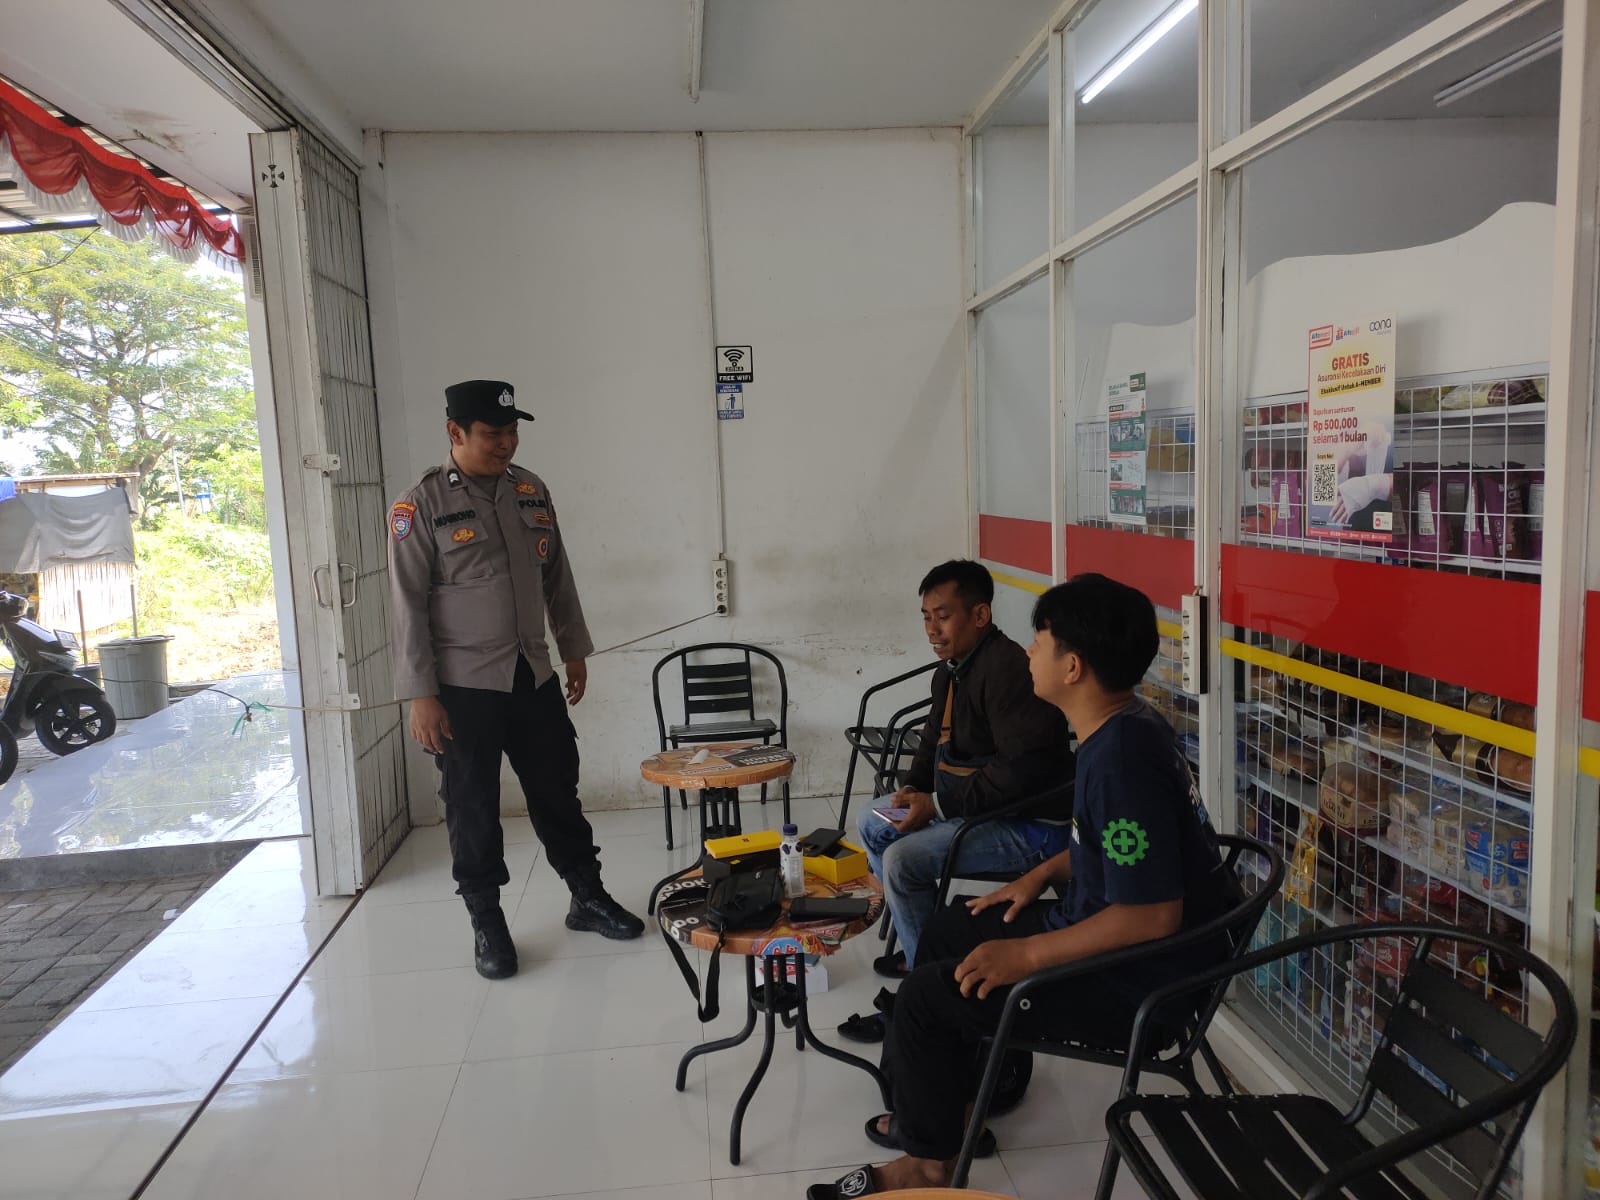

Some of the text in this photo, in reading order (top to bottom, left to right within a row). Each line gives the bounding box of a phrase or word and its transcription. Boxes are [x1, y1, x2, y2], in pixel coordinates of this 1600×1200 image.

[1331, 352, 1370, 370] GRATIS
[1375, 363, 1386, 374] Diri
[1313, 417, 1358, 433] Rp 500,000
[1312, 430, 1368, 445] selama 1 bulan
